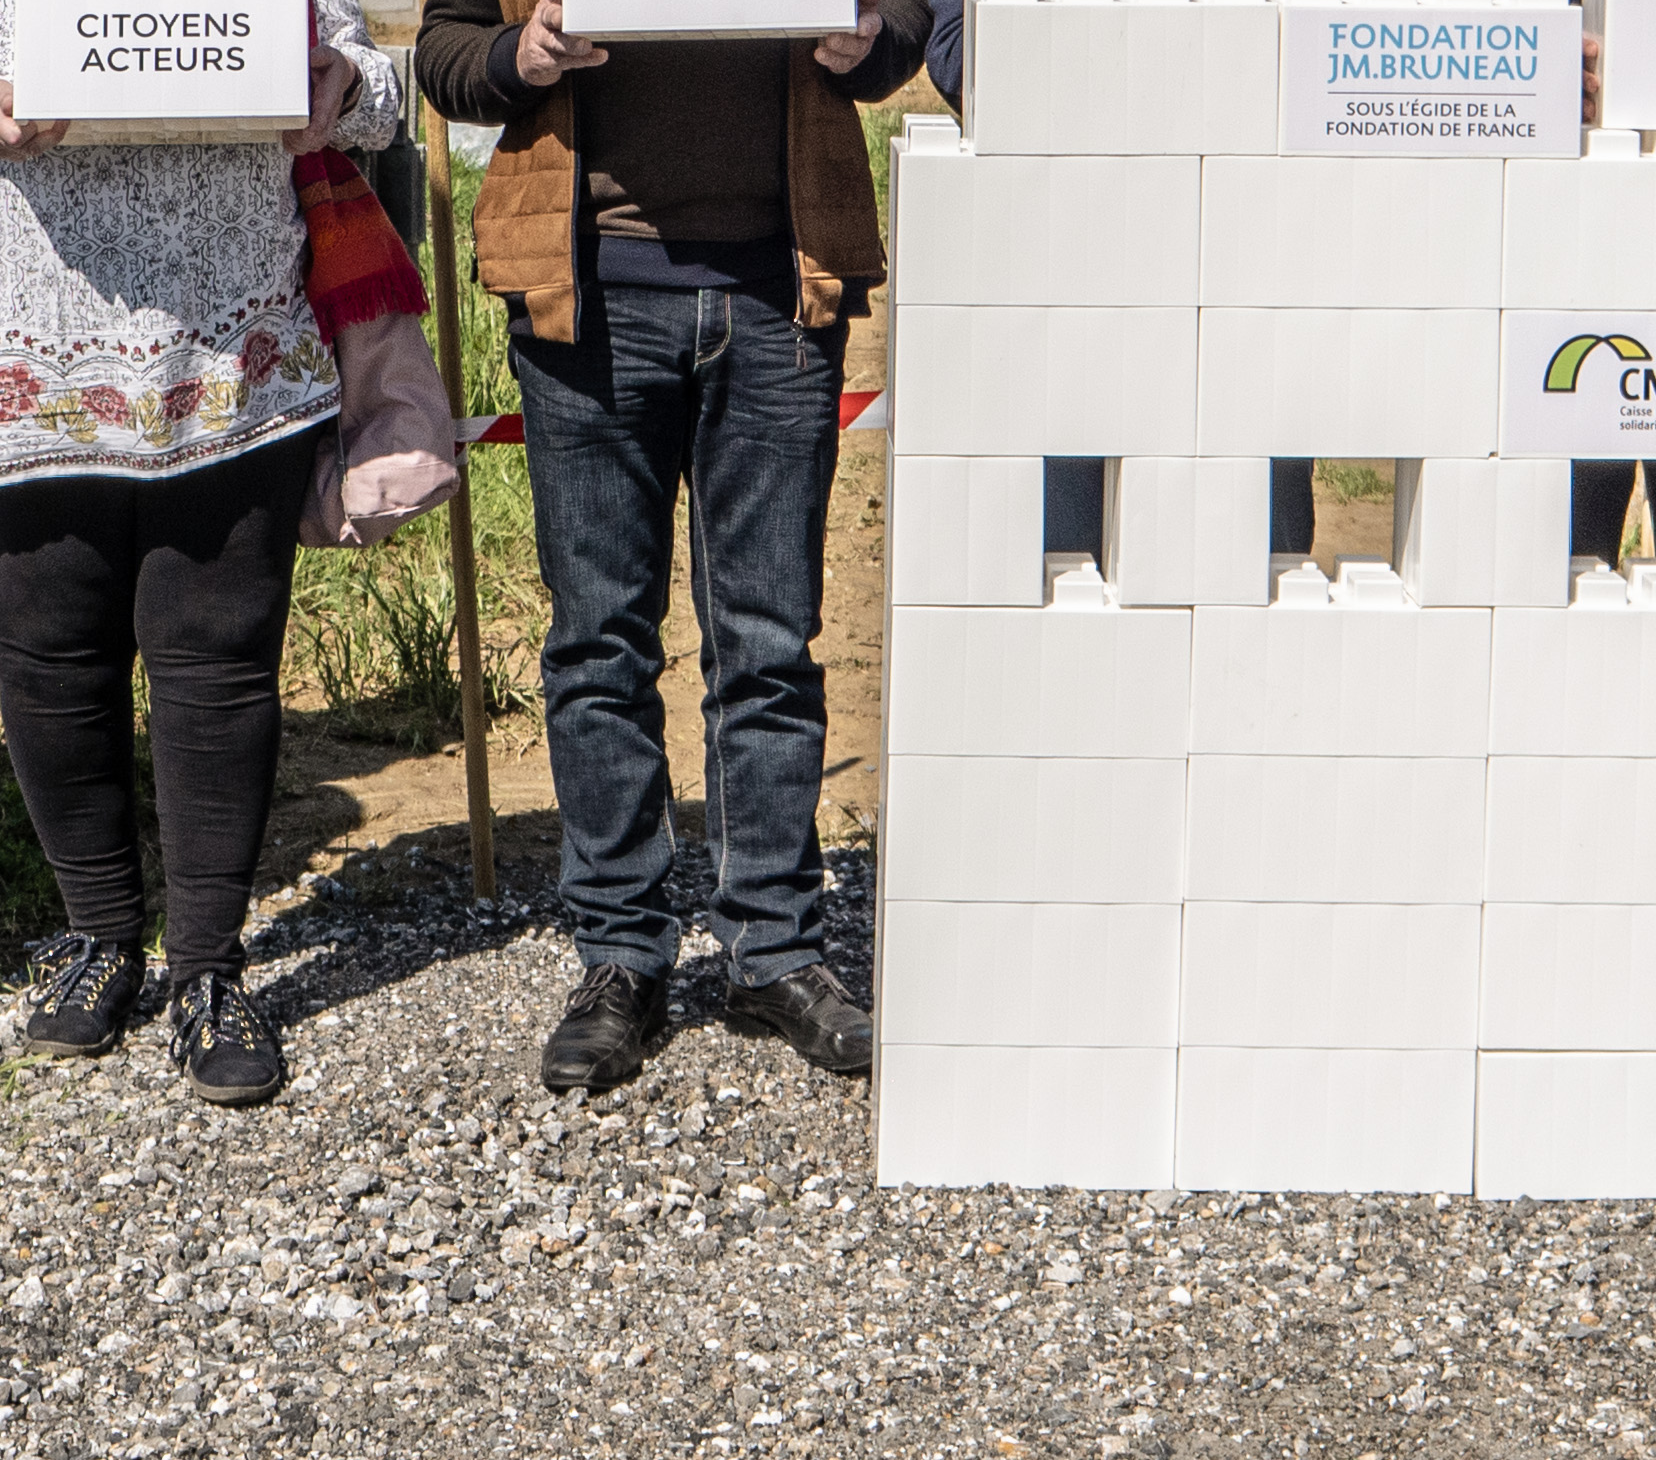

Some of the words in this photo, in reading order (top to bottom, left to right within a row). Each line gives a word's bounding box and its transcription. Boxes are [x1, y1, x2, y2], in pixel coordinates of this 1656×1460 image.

[76, 13, 251, 38] CITOYENS
[1328, 23, 1538, 51] FONDATION
[81, 47, 245, 72] ACTEURS
[1327, 54, 1538, 84] JM.BRUNEAU
[1346, 102, 1394, 117] SOUS
[1400, 99, 1462, 117] L'ÉGIDE
[1467, 103, 1489, 117] DE
[1494, 103, 1516, 117] LA
[1326, 122, 1434, 136] FONDATION
[1440, 123, 1461, 137] DE
[1468, 123, 1536, 137] FRANCE
[1620, 406, 1653, 417] Caisse
